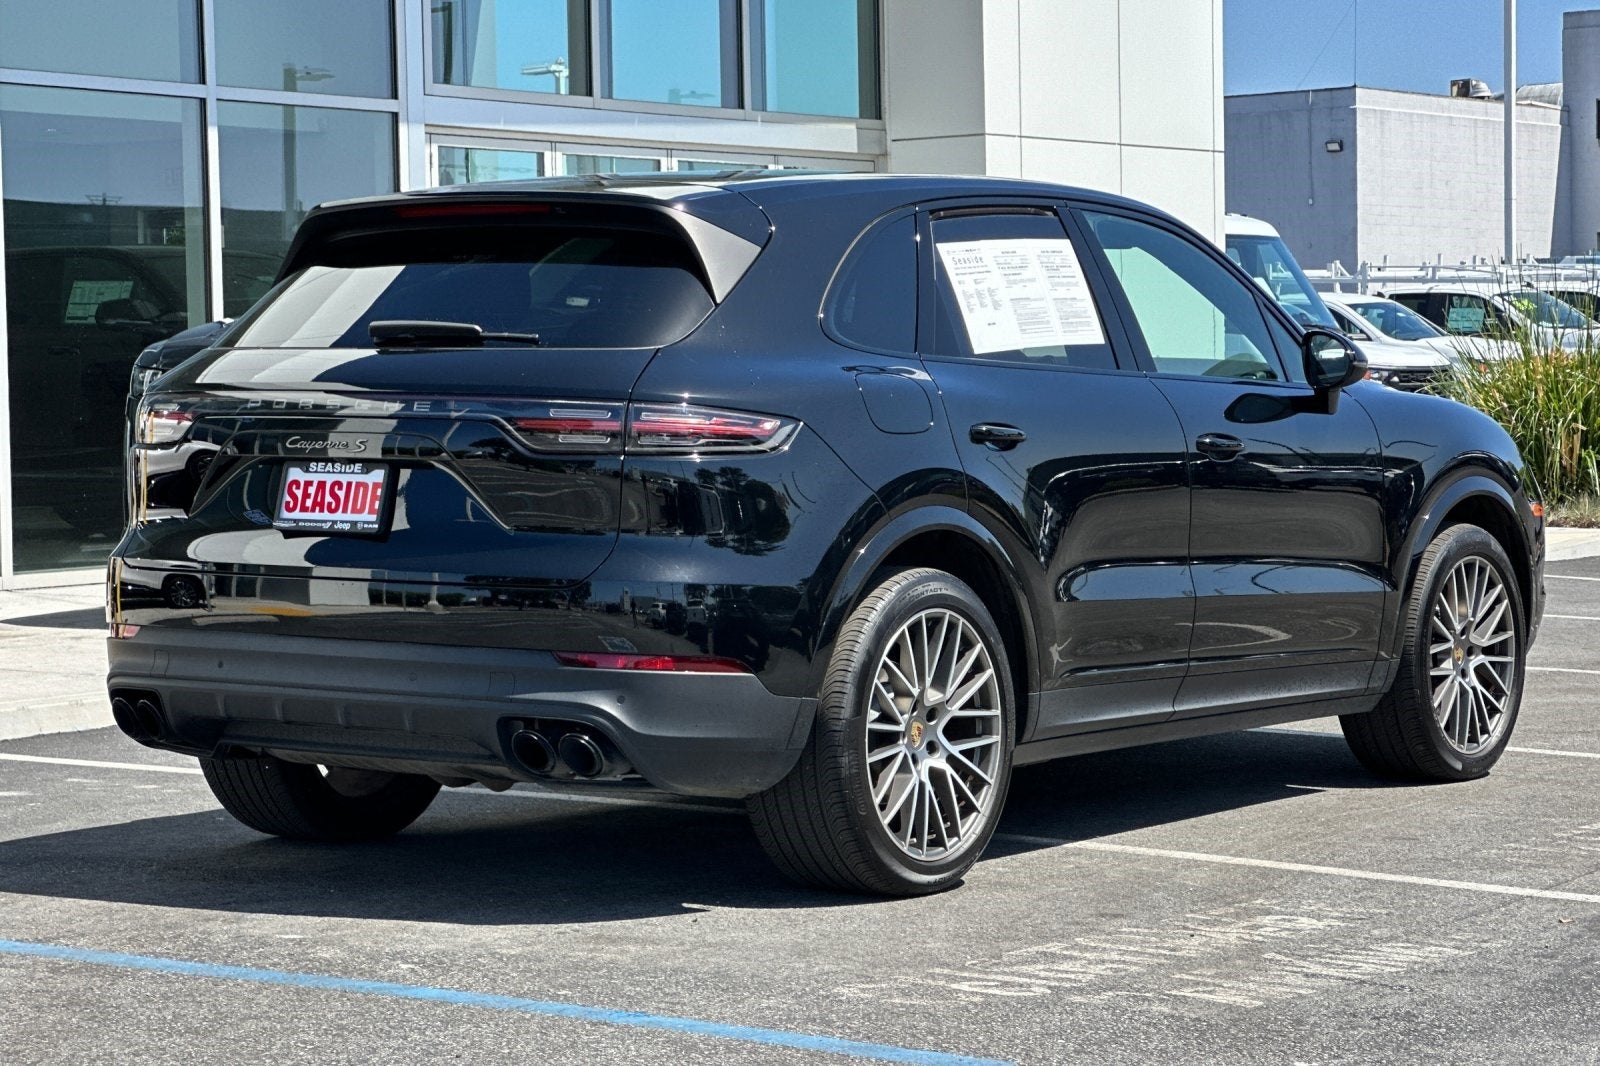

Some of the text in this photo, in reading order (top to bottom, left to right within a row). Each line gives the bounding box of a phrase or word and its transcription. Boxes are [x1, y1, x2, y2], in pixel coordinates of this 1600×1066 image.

[247, 398, 432, 412] PORSCHE
[285, 435, 368, 453] Cayenne S
[308, 461, 363, 473] SEASIDE
[284, 479, 382, 515] SEASIDE
[333, 520, 351, 531] Jeep
